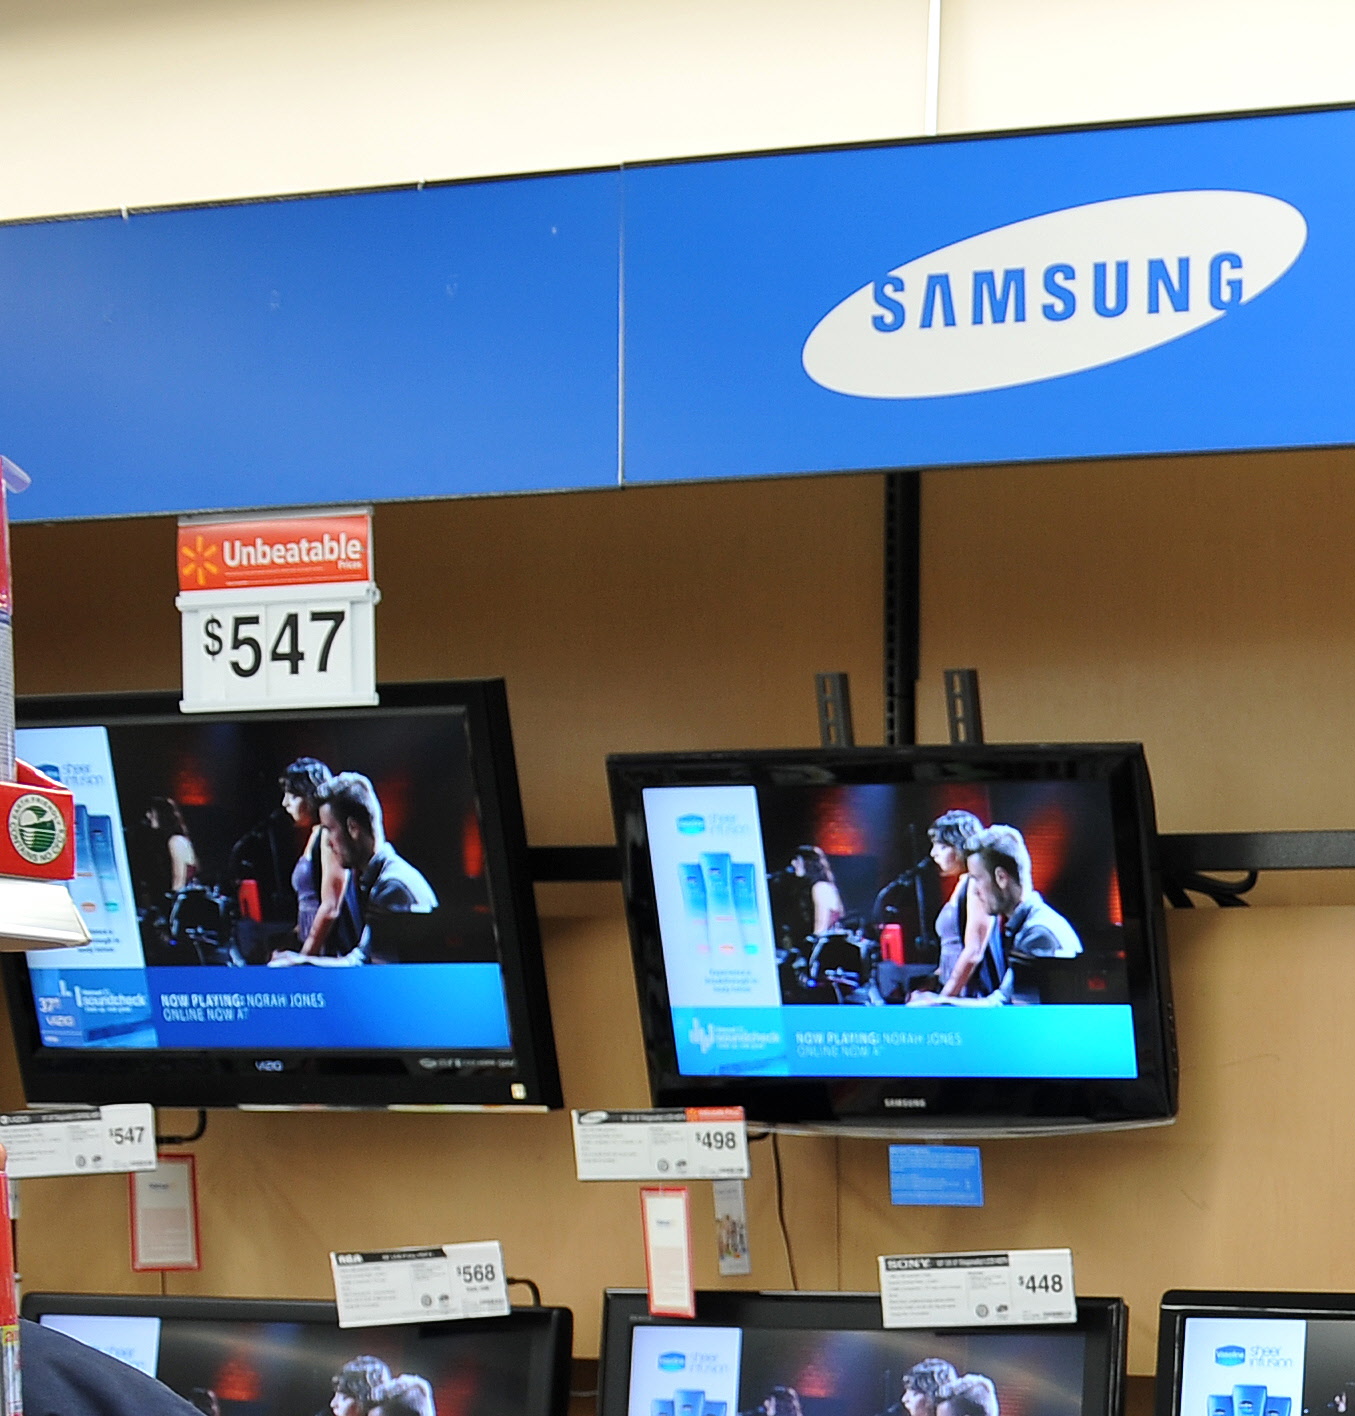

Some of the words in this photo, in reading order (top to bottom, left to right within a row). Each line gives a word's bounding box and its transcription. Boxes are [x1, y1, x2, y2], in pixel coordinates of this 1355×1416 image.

[871, 252, 1243, 333] SAMSUNG
[223, 532, 362, 567] Unbeatable
[203, 610, 345, 678] $547
[161, 993, 189, 1008] NOW
[192, 993, 246, 1008] PLAYING:
[247, 993, 286, 1007] NORAH
[290, 993, 326, 1008] JONES
[163, 1008, 204, 1021] ONLINE
[206, 1008, 236, 1021] NOW
[795, 1032, 823, 1045] NOW
[826, 1032, 880, 1045] PLAYING:
[882, 1032, 924, 1045] NORAH
[927, 1032, 962, 1046] JONES
[797, 1045, 838, 1057] ONLINE
[842, 1045, 870, 1057] NOW
[884, 1098, 927, 1108] SAMSUNG
[108, 1126, 145, 1145] $547
[695, 1131, 736, 1150] $498
[456, 1264, 496, 1283] $568
[887, 1258, 930, 1270] SONY
[1018, 1273, 1064, 1294] $448
